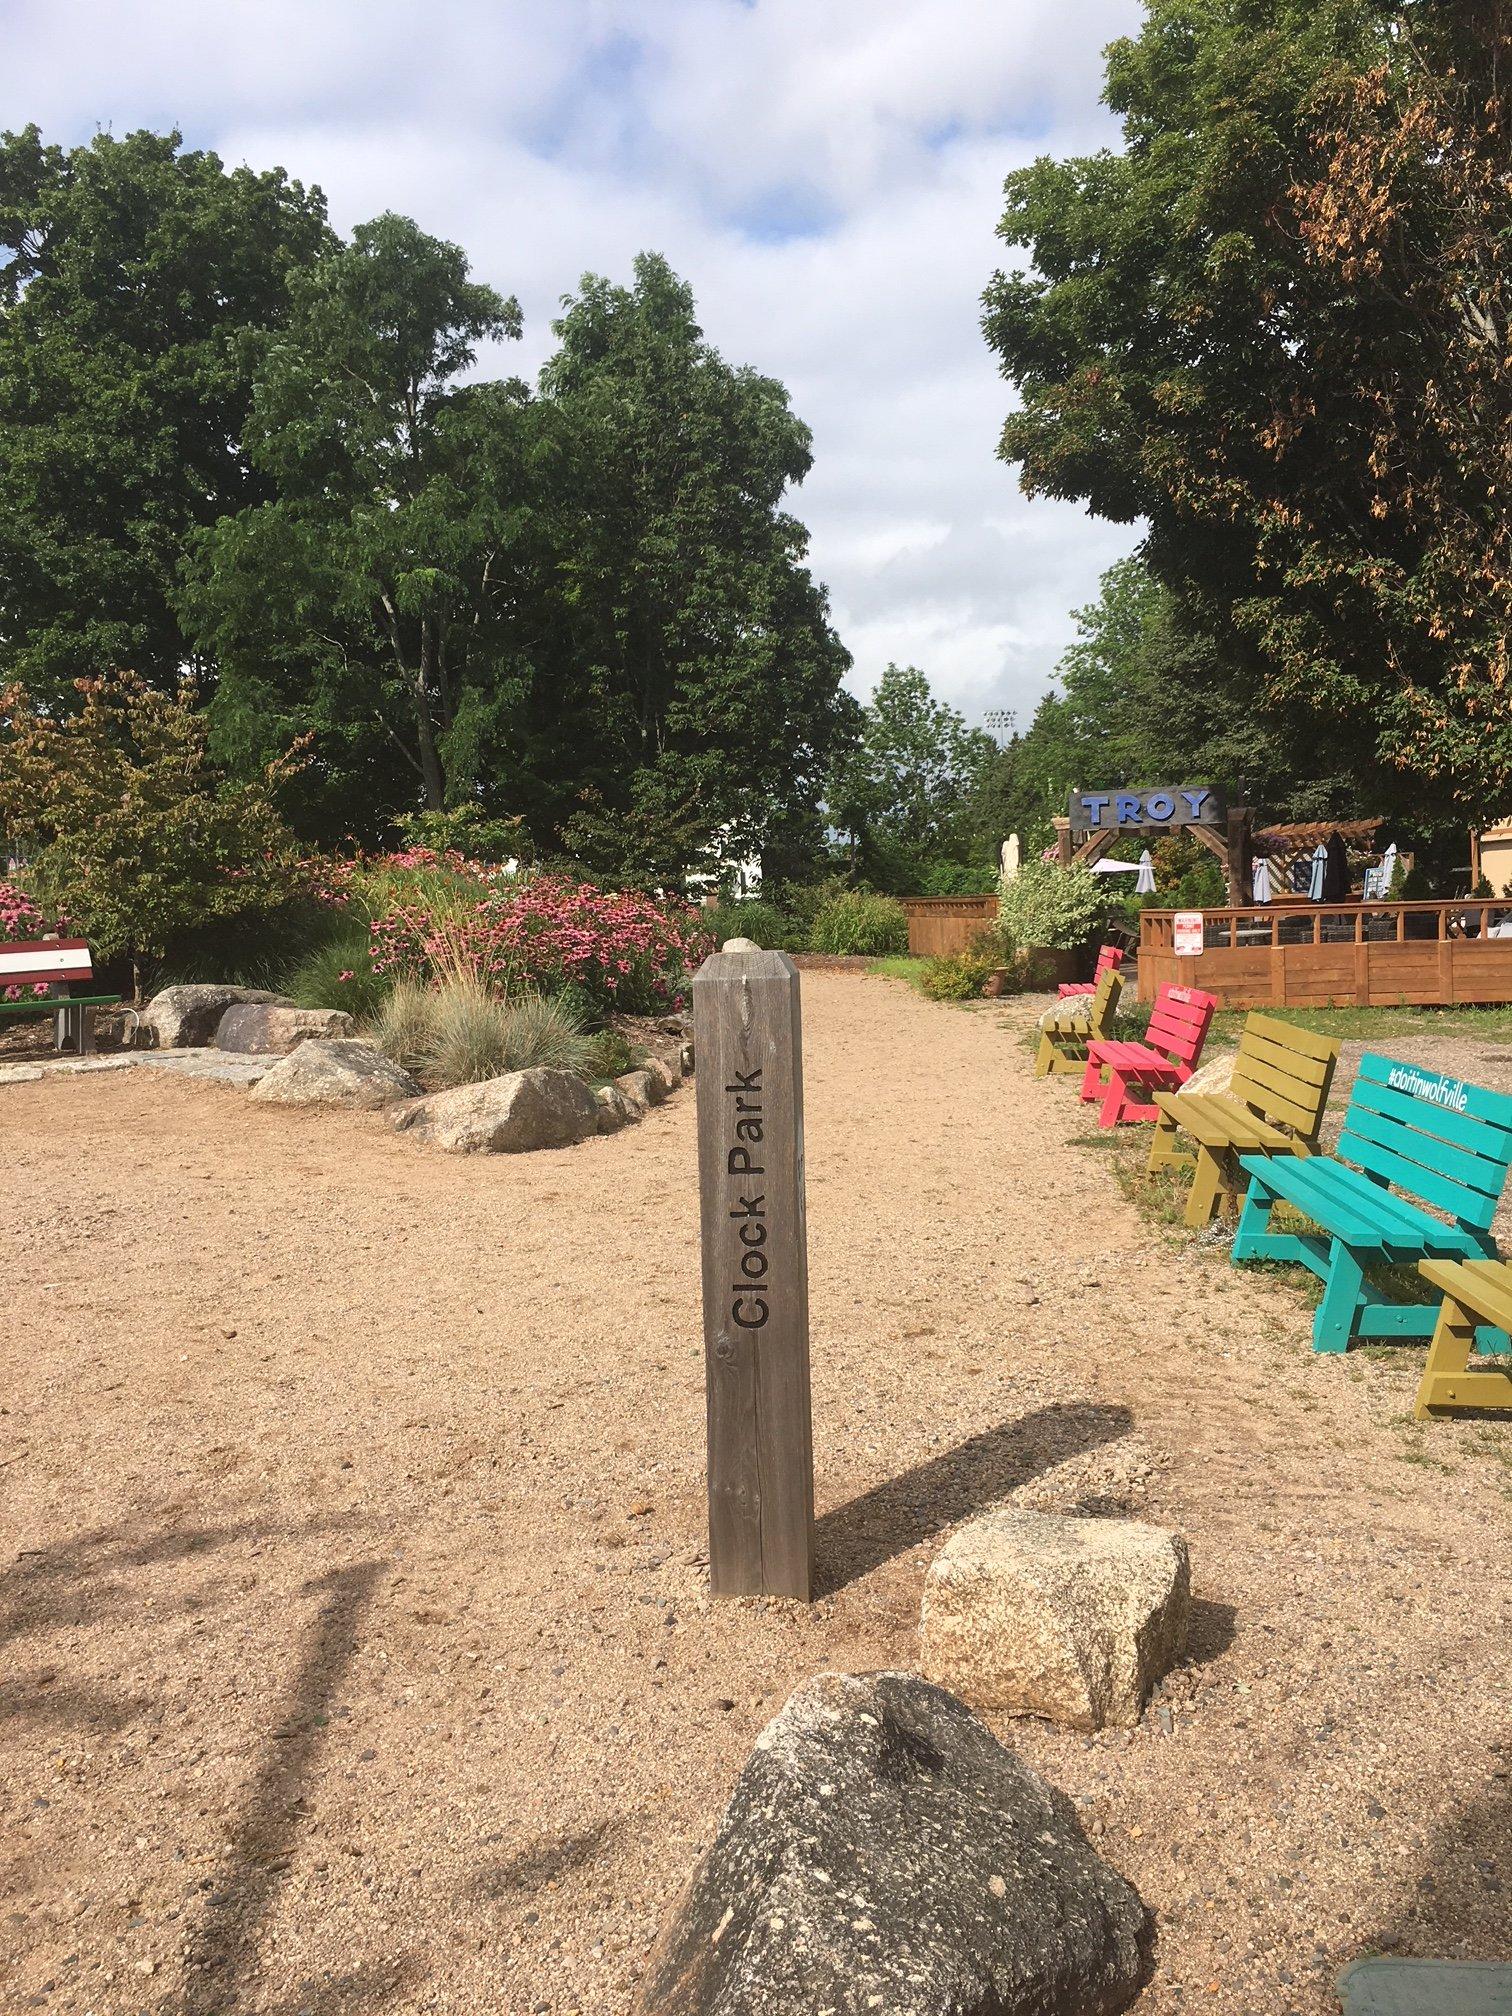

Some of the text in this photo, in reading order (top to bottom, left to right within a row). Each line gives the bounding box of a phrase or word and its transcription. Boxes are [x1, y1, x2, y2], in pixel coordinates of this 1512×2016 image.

[1081, 791, 1210, 825] TROY
[1387, 1066, 1468, 1112] #doitinwolfville
[725, 1068, 769, 1330] Clock Park
